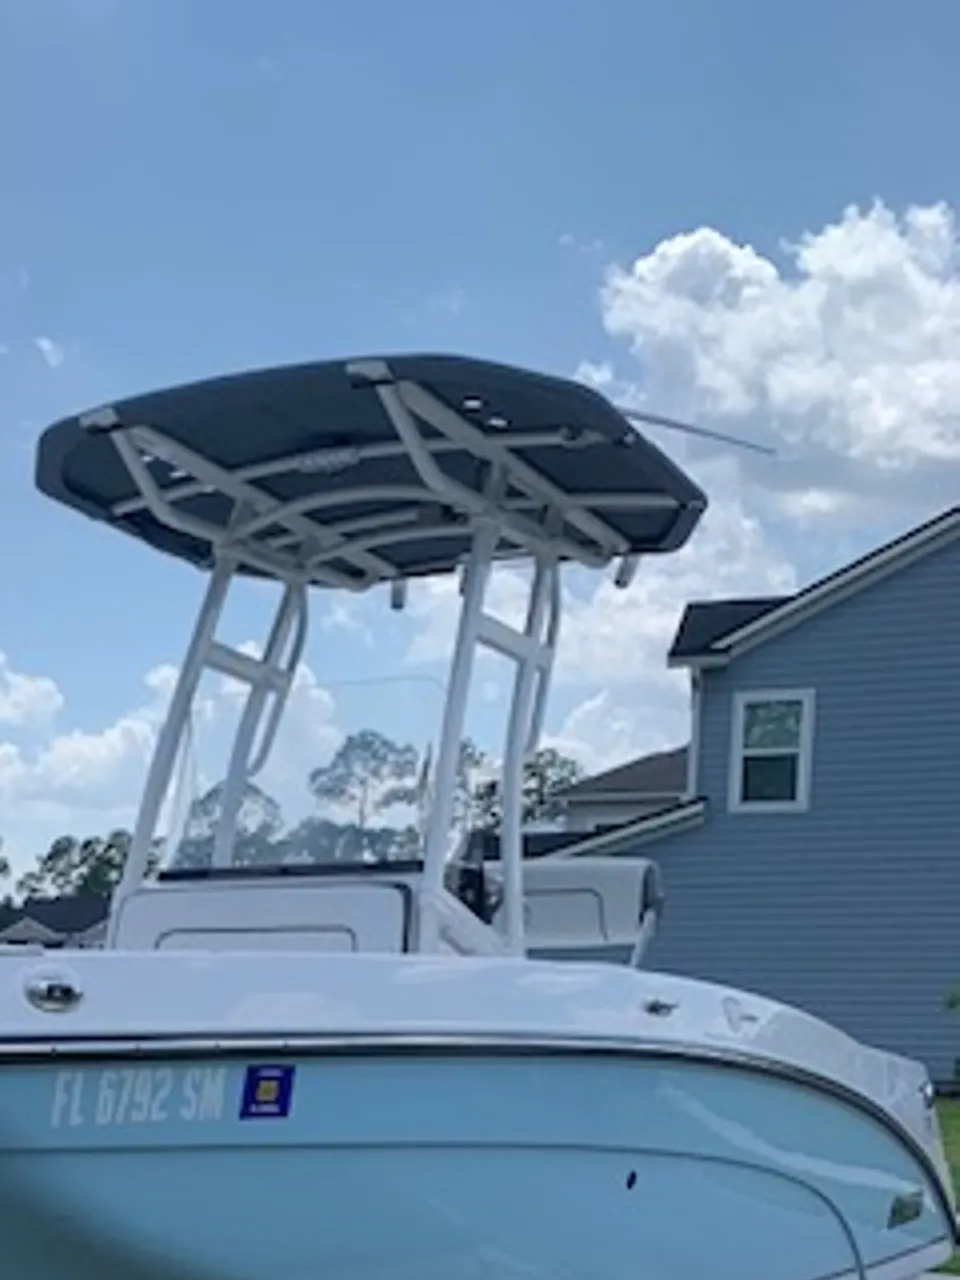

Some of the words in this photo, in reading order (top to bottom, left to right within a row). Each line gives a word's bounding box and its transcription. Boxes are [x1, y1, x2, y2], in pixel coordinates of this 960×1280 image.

[50, 1071, 84, 1127] FL
[95, 1068, 173, 1126] 6792
[179, 1066, 227, 1120] SM
